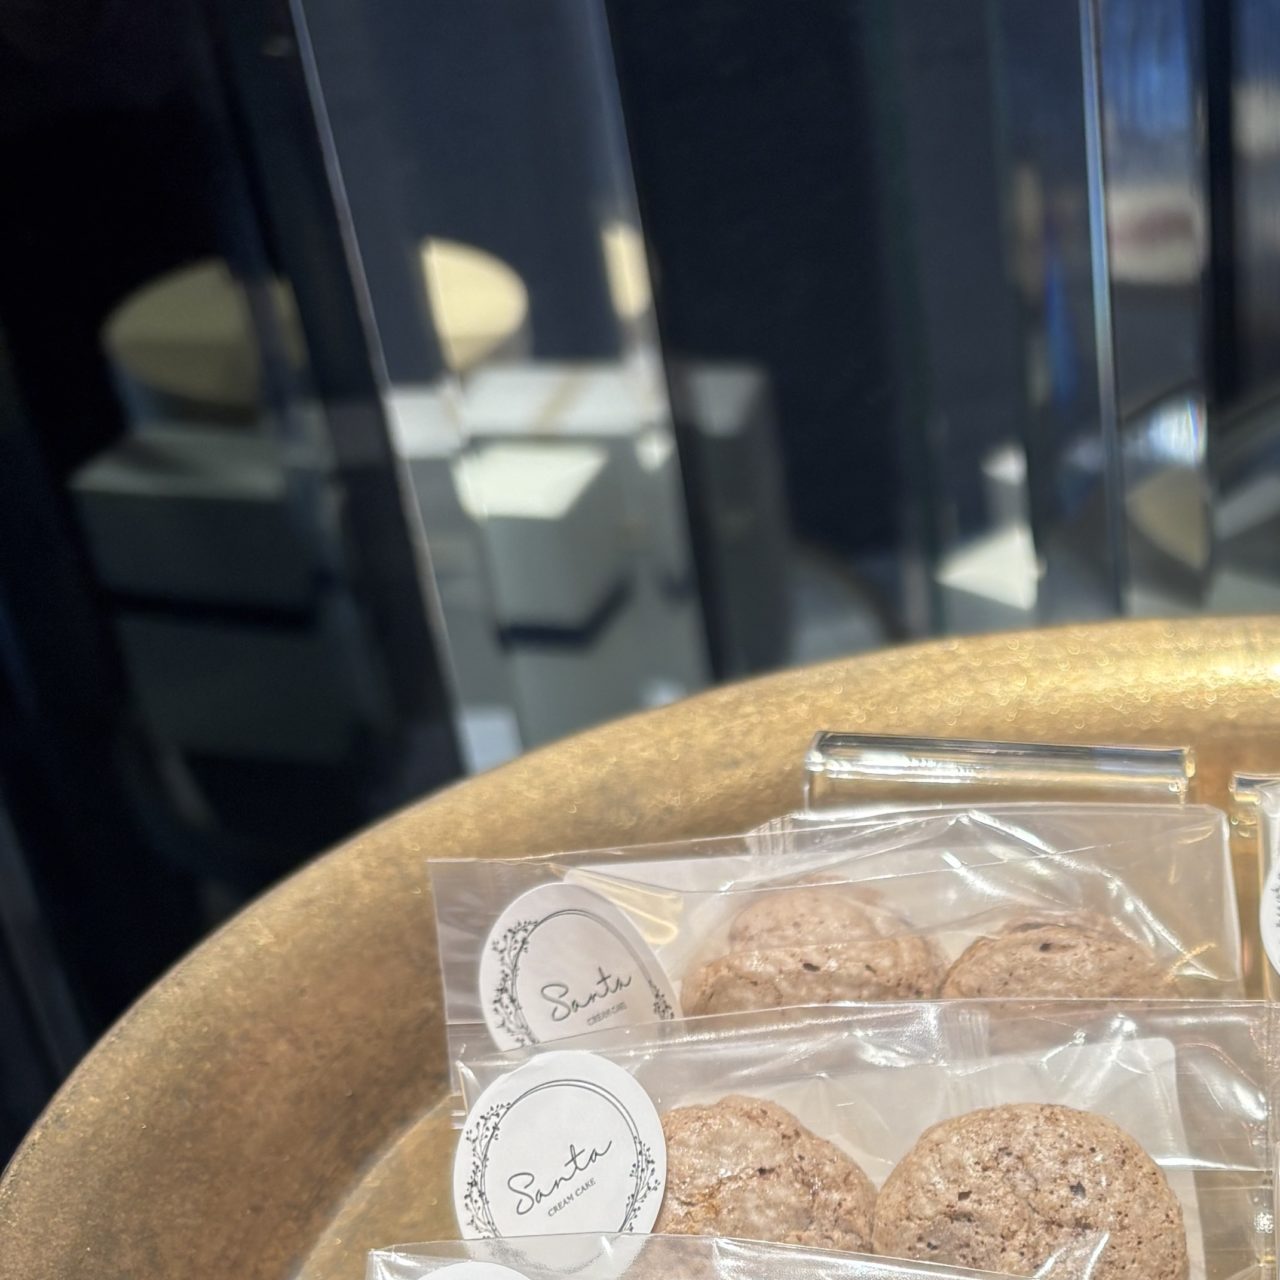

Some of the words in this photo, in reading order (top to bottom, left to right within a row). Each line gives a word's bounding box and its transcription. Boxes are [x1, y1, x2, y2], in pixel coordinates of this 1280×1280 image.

[540, 966, 633, 1022] Santa
[507, 1140, 613, 1216] Santa
[547, 1193, 575, 1217] CREAM
[574, 1177, 597, 1198] CAKE
